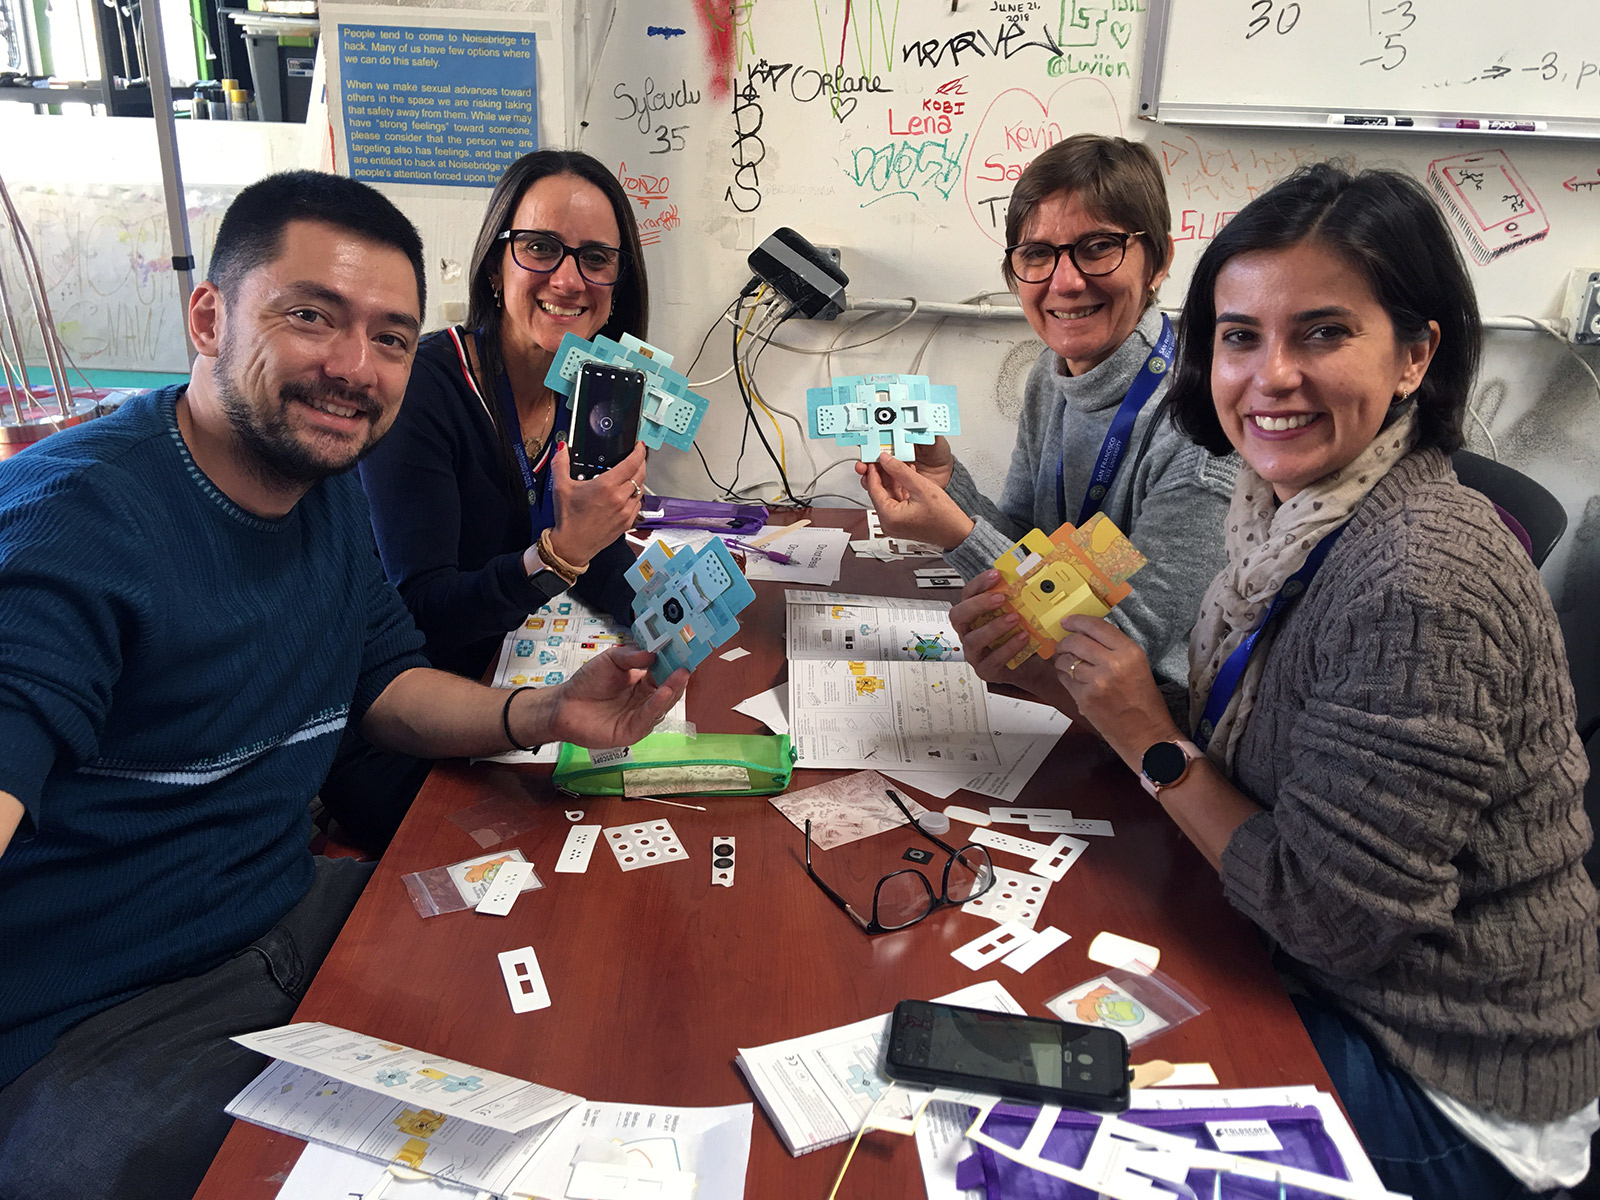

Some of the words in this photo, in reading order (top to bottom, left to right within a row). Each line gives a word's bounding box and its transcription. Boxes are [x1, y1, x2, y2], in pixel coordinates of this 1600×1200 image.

[990, 1, 1024, 13] JUNE
[1381, 0, 1416, 32] -3
[1006, 14, 1030, 23] 2018
[1245, 0, 1301, 39] 30
[344, 28, 376, 40] People
[380, 30, 400, 39] tend
[405, 32, 414, 40] to
[448, 34, 458, 42] to
[462, 33, 516, 46] Noisebridge
[521, 37, 530, 46] to
[344, 42, 368, 51] hack.
[372, 42, 396, 54] Many
[399, 44, 408, 52] of
[424, 45, 446, 54] have
[448, 46, 464, 54] few
[467, 47, 500, 58] options
[503, 50, 530, 58] where
[1360, 34, 1407, 71] -5
[379, 56, 391, 64] do
[393, 57, 409, 66] this
[412, 57, 440, 69] safely.
[346, 80, 372, 89] When
[393, 82, 418, 91] make
[421, 84, 450, 93] sexual
[454, 85, 498, 96] advances
[502, 88, 532, 97] toward
[347, 94, 375, 102] others
[378, 94, 386, 103] in
[390, 95, 404, 103] the
[408, 98, 434, 106] space
[473, 99, 502, 110] risking
[505, 101, 532, 112] taking
[922, 98, 965, 115] KOBI
[348, 106, 365, 114] that
[367, 106, 394, 118] safety
[397, 109, 419, 119] away
[422, 108, 441, 118] from
[444, 110, 468, 119] them.
[471, 111, 496, 120] While
[513, 115, 532, 124] may
[888, 108, 953, 135] Lena
[349, 118, 371, 127] have
[376, 119, 407, 131] "strong
[412, 121, 449, 133] feelings"
[454, 123, 484, 133] toward
[489, 126, 532, 136] someone,
[1004, 120, 1064, 152] Kevin
[351, 131, 380, 140] please
[385, 133, 422, 142] consider
[427, 134, 443, 143] that
[448, 135, 462, 144] the
[466, 138, 496, 146] person
[649, 125, 690, 154] 35
[352, 143, 391, 155] targeting
[394, 145, 412, 154] also
[416, 146, 432, 155] has
[434, 147, 472, 158] feelings,
[475, 150, 492, 158] and
[495, 150, 511, 159] that
[370, 157, 402, 166] entitled
[415, 158, 435, 167] hack
[449, 160, 500, 172] Noisebridge
[355, 169, 391, 178] people's
[394, 170, 431, 179] attention
[434, 171, 461, 180] forced
[464, 174, 485, 182] upon
[1096, 469, 1105, 482] SAN
[1102, 436, 1117, 468] FRANCISCO
[1109, 440, 1122, 468] UNIVERSITY
[593, 752, 624, 764] FOLDSCOPE
